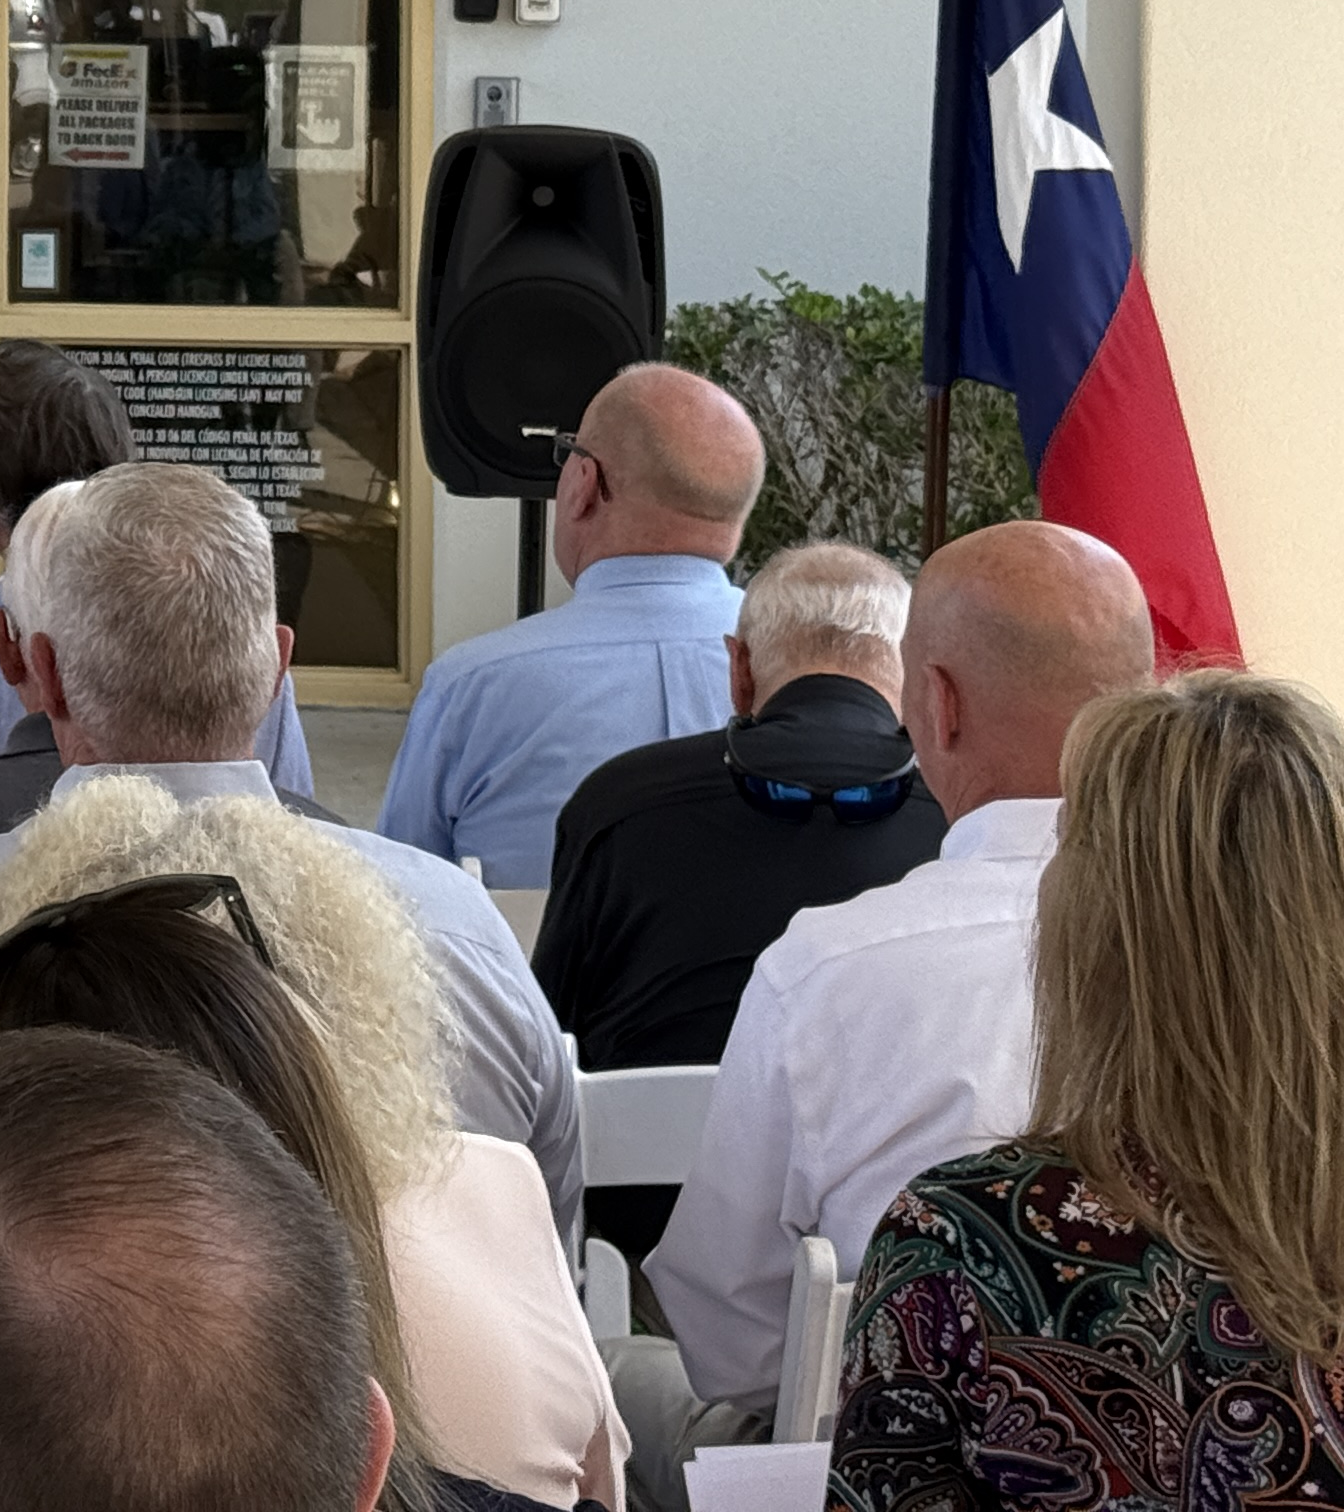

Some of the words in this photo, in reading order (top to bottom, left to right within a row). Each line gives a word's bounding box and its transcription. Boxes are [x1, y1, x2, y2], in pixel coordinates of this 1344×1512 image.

[55, 98, 94, 112] PLEASE
[96, 99, 139, 113] DELIVER
[58, 115, 76, 129] ALL
[78, 116, 136, 130] PACKAGES
[57, 132, 71, 146] TO
[73, 132, 103, 146] BACK
[157, 353, 180, 366] CODE
[238, 355, 271, 368] LICENSE
[272, 355, 306, 368] HOLDER
[145, 371, 178, 384] PERSON
